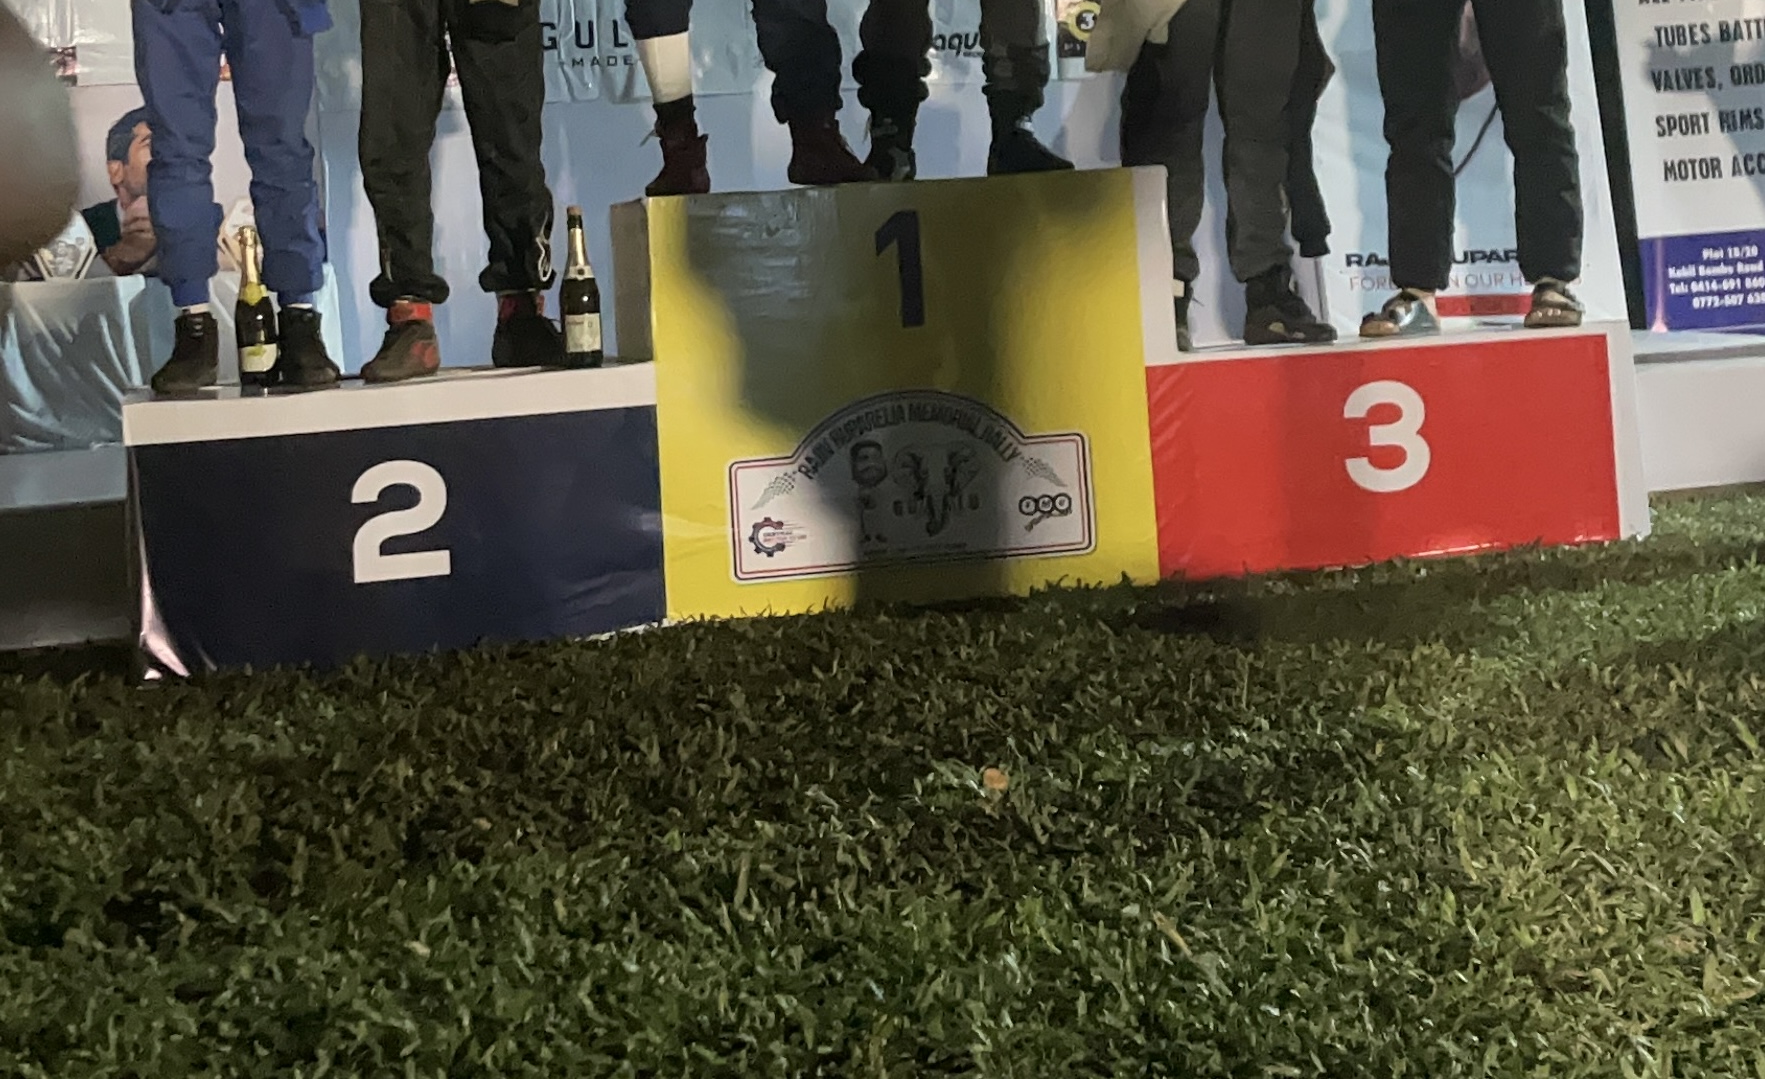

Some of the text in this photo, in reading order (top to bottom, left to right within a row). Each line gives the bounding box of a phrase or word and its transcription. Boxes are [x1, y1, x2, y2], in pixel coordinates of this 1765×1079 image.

[1654, 17, 1765, 48] TUBES BATT
[571, 55, 634, 68] MADE
[1650, 66, 1724, 93] VALVES,
[1655, 107, 1765, 138] SPORT RIMS
[1663, 156, 1723, 182] MOTOR
[874, 209, 926, 329] 1
[1464, 272, 1504, 288] OUR
[1342, 378, 1432, 493] 3
[350, 458, 452, 585] 2
